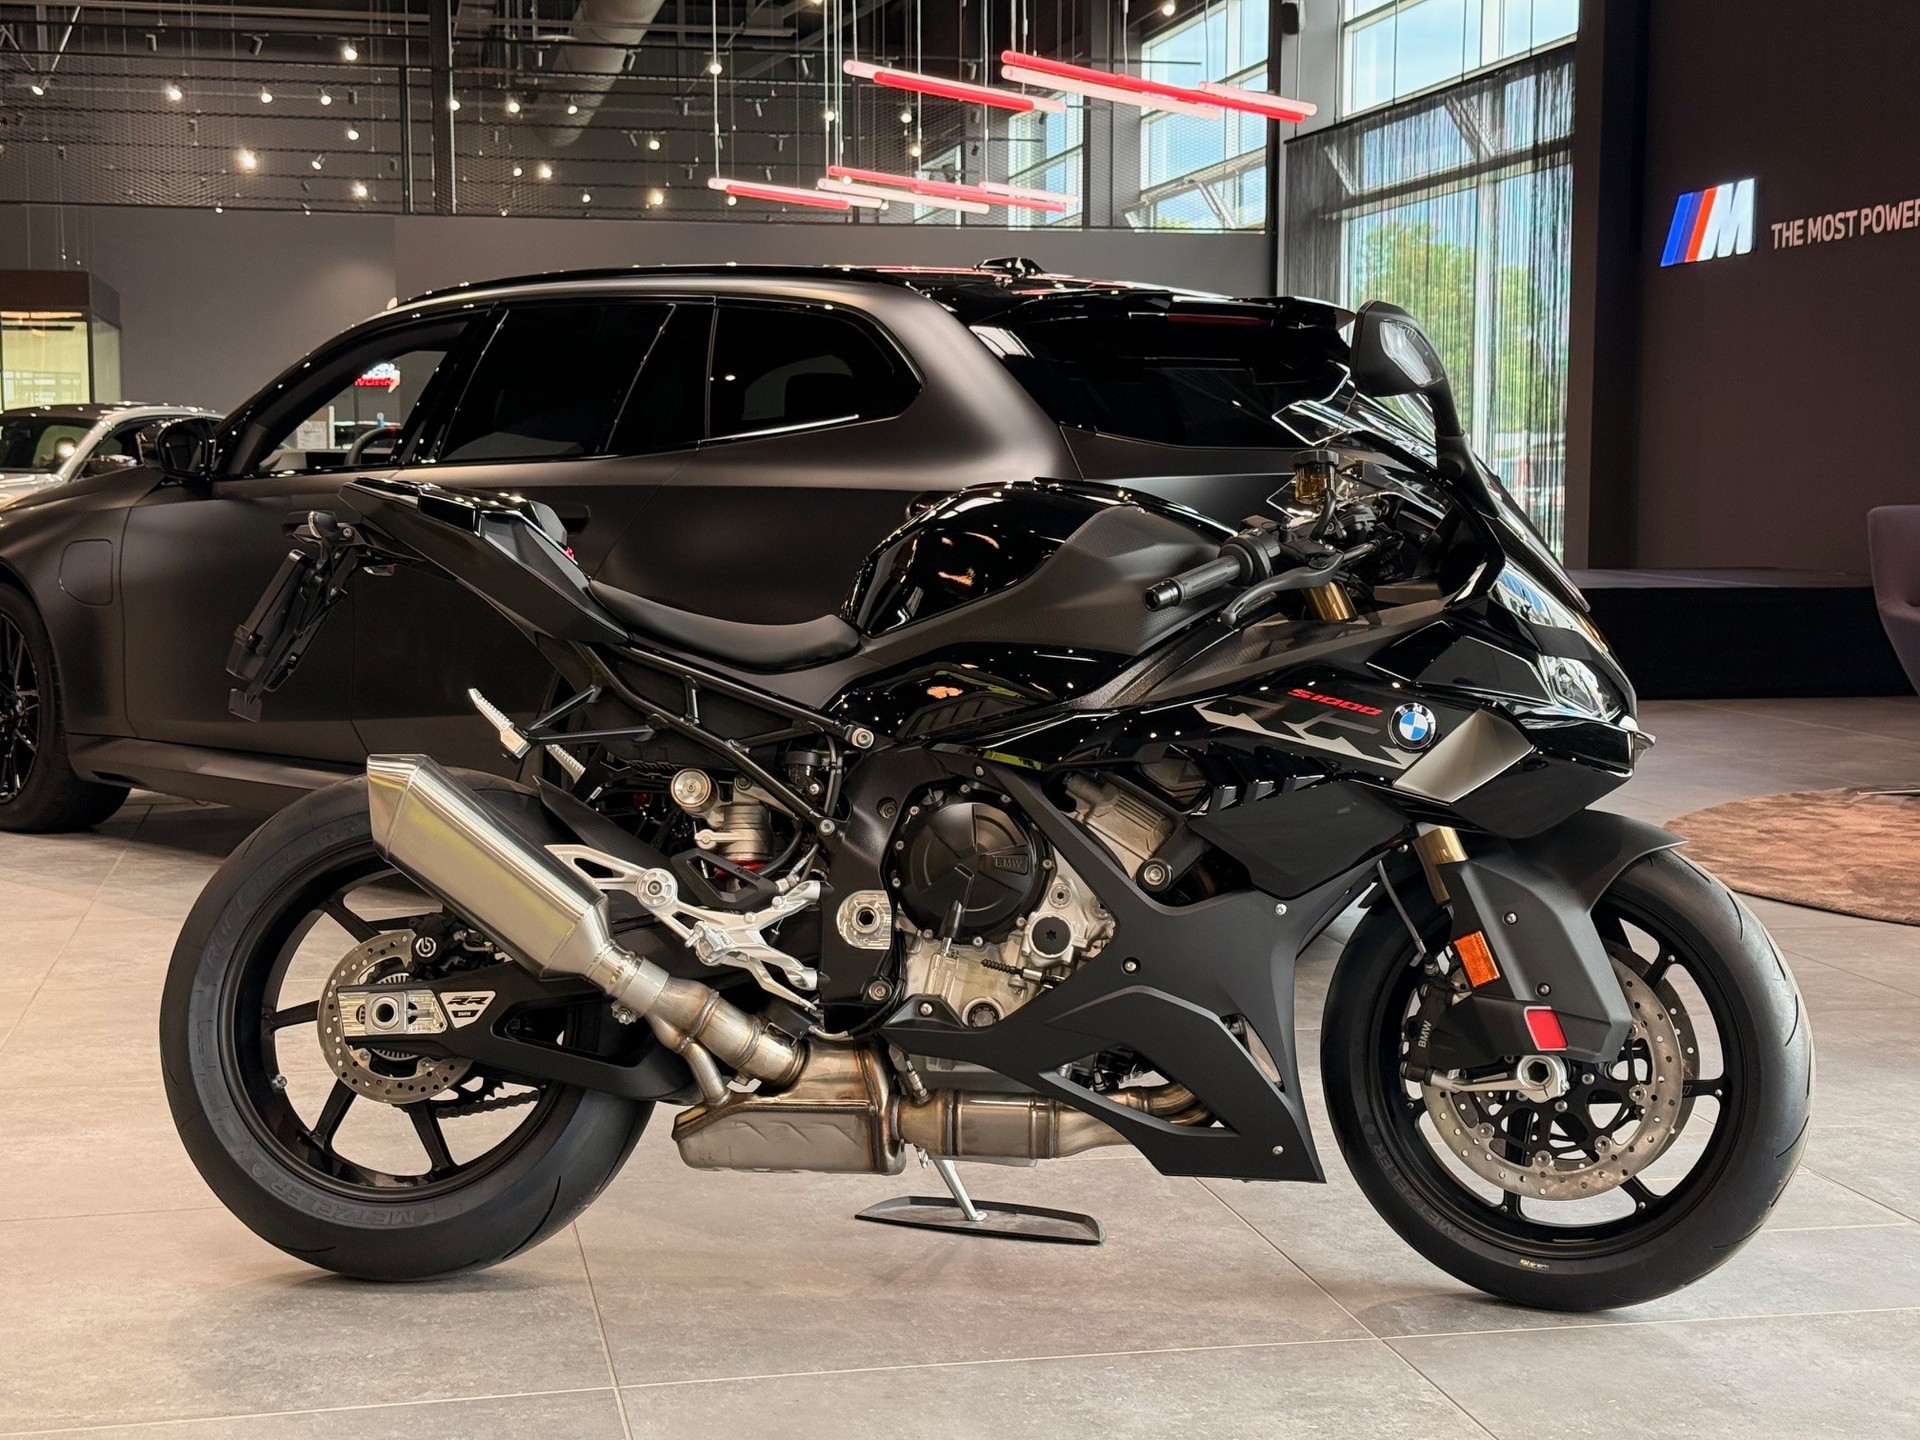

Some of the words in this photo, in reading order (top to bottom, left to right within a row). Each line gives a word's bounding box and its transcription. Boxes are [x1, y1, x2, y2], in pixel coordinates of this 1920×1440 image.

[1771, 219, 1804, 250] THE
[1807, 209, 1858, 245] MOST
[1288, 688, 1383, 716] S1000
[1418, 1020, 1432, 1048] BMW
[269, 1179, 417, 1226] METZELER
[1371, 1143, 1459, 1236] METZELER
